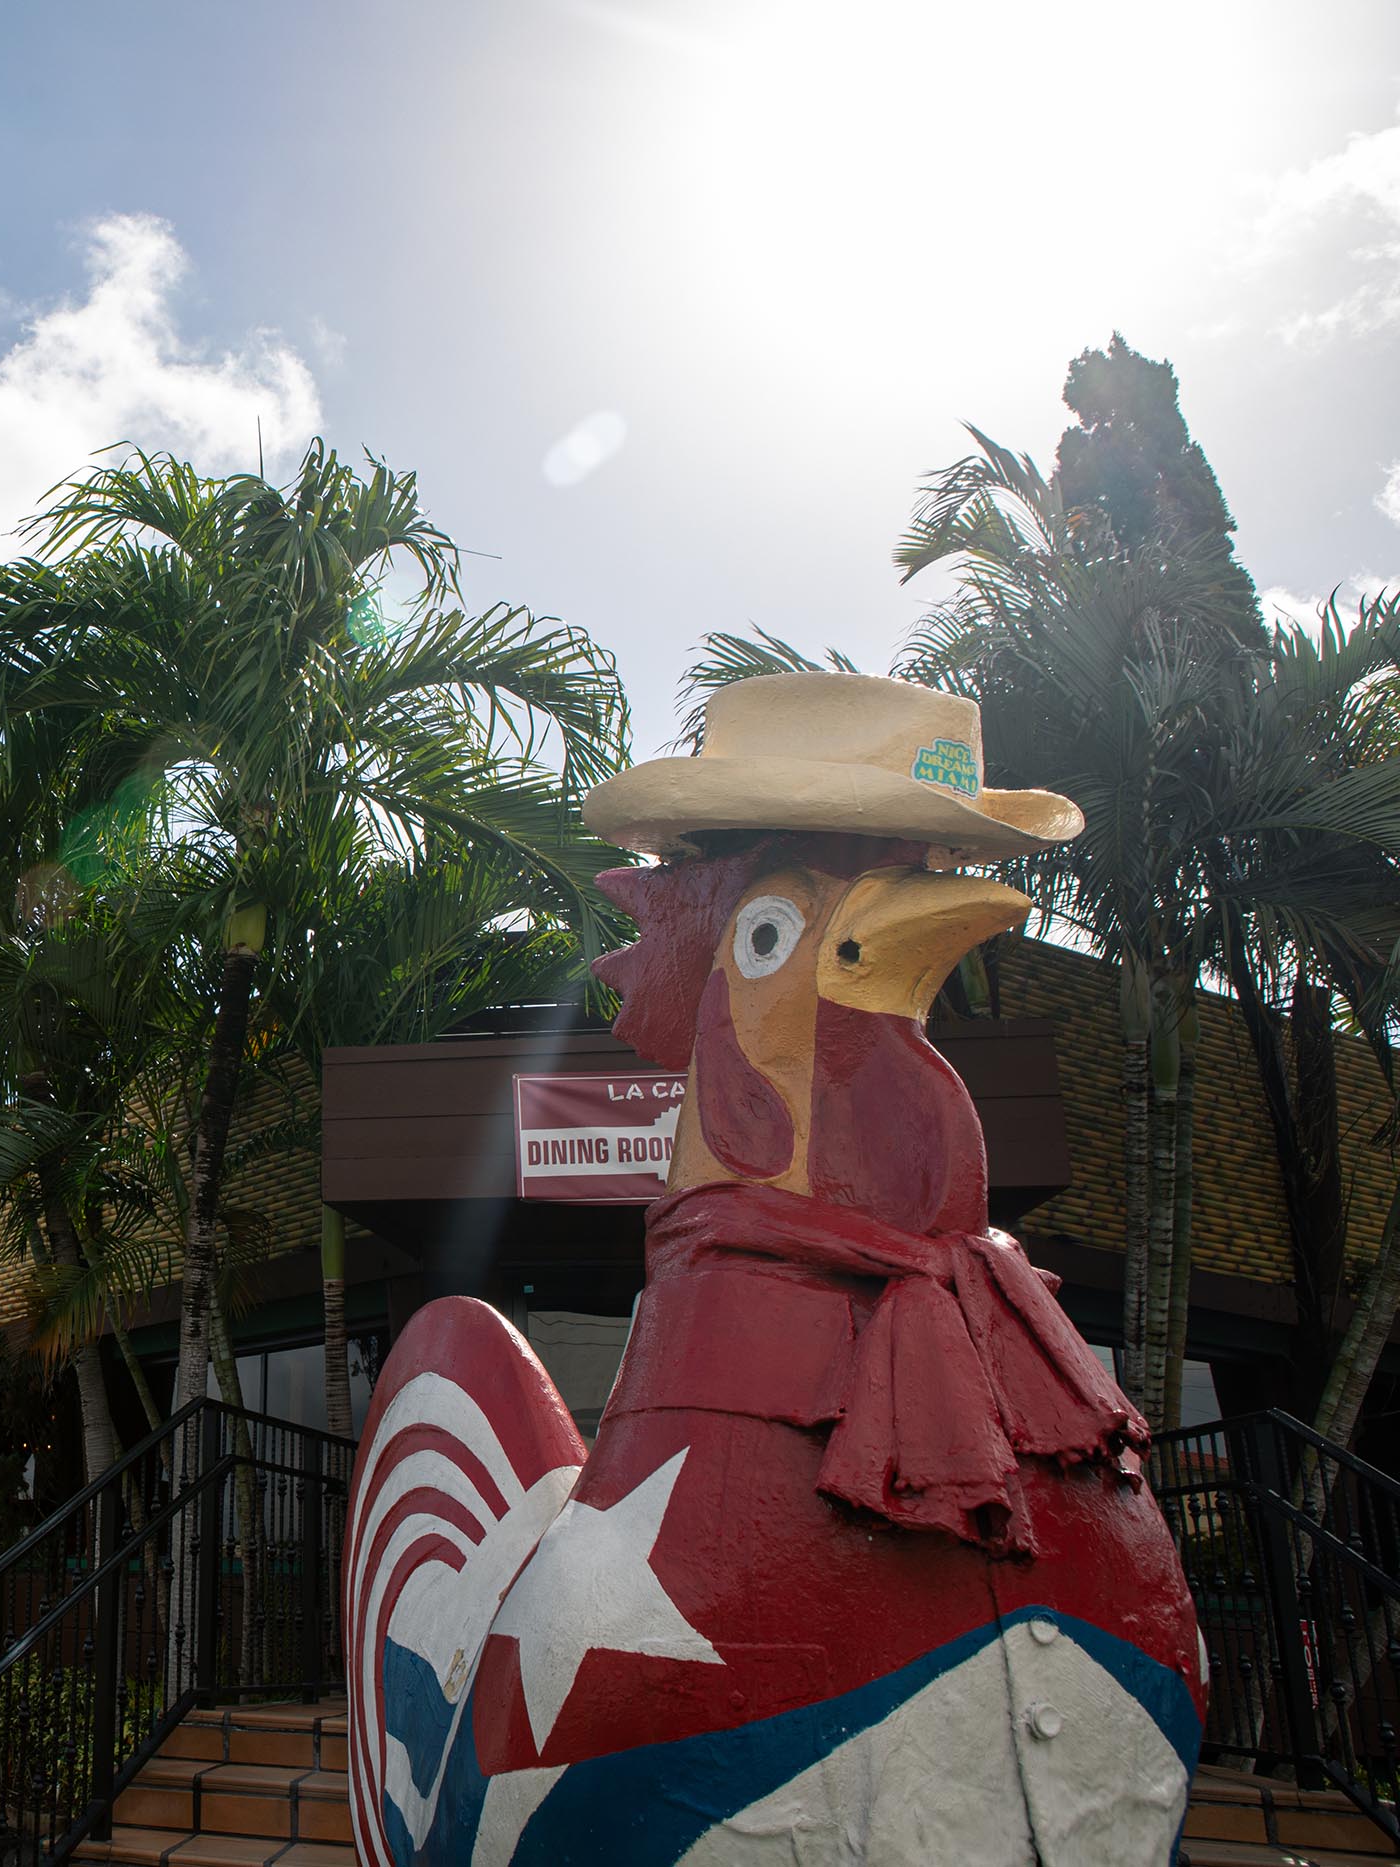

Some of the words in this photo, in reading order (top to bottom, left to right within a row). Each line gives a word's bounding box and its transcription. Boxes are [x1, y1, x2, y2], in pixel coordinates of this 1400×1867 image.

[937, 742, 969, 763] NICE
[916, 766, 976, 793] MIAMI
[607, 1083, 645, 1101] LA
[652, 1081, 687, 1099] CA
[528, 1137, 609, 1166] DINING
